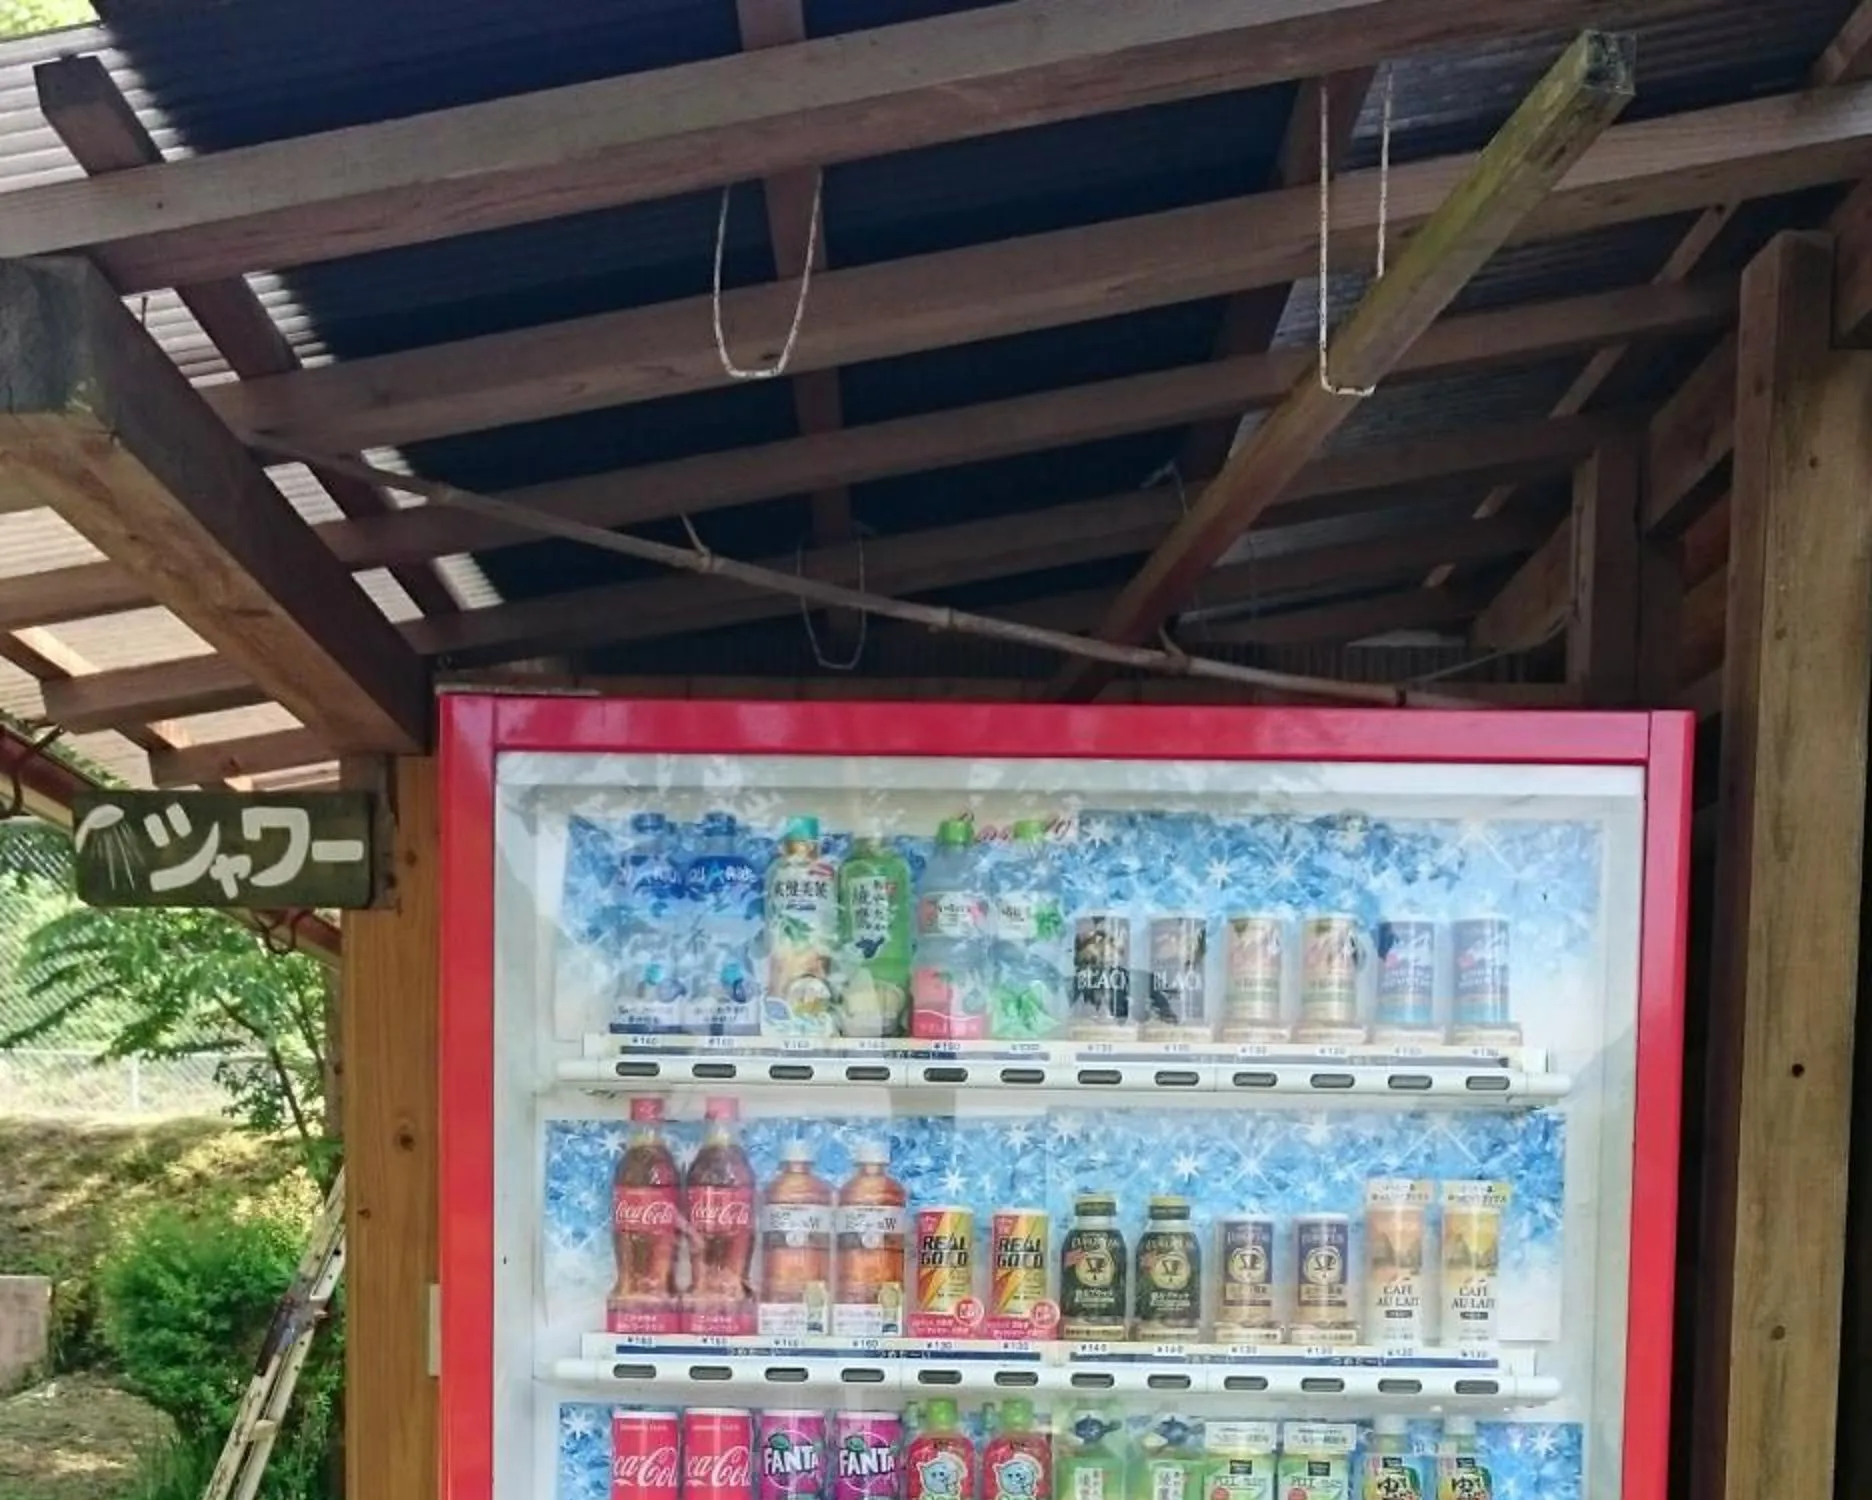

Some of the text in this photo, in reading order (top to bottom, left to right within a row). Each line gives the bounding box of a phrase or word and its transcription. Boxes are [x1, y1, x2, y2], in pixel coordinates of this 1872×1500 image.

[144, 802, 363, 899] シャワー
[923, 1232, 967, 1251] REAL
[999, 1234, 1042, 1252] REAL
[764, 1446, 820, 1476] FANTA
[838, 1447, 896, 1476] FANTA
